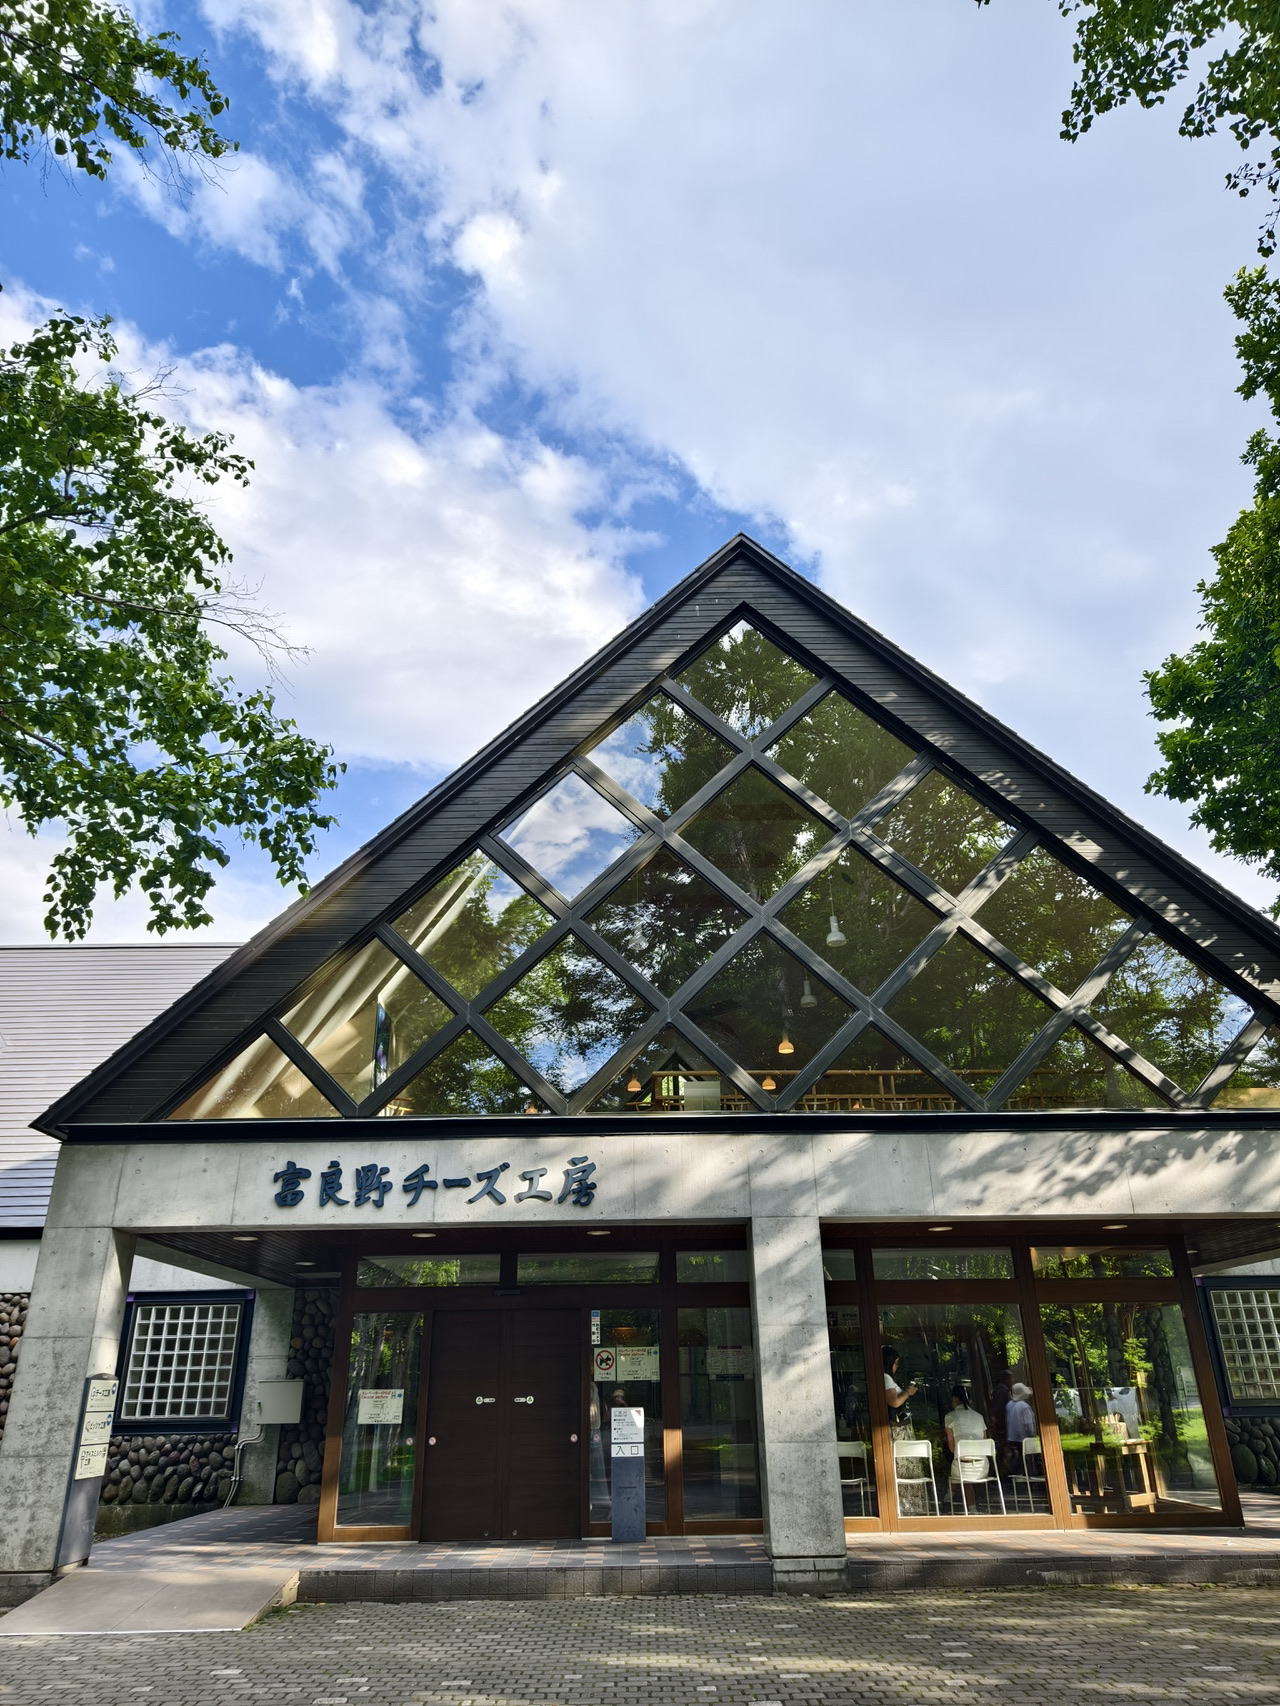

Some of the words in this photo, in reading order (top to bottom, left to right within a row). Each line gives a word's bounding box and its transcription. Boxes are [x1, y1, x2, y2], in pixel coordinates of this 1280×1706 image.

[273, 1156, 597, 1208] 富良野チーズ工房
[615, 1445, 639, 1456] 入口
